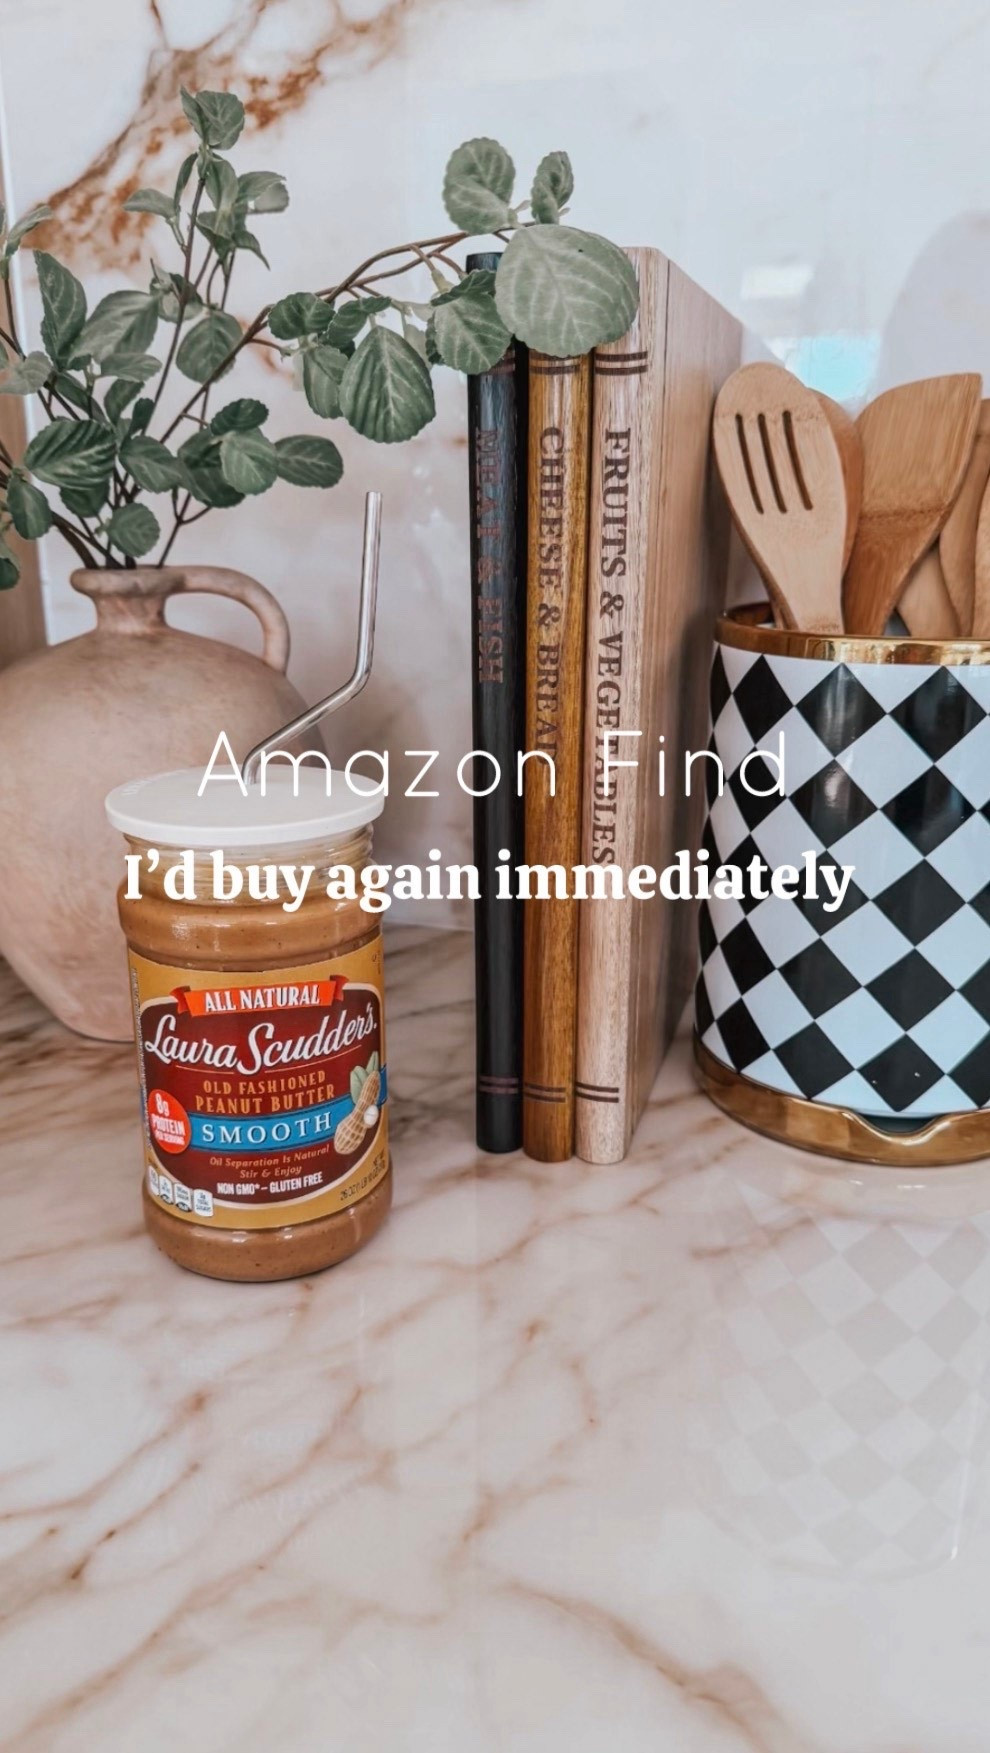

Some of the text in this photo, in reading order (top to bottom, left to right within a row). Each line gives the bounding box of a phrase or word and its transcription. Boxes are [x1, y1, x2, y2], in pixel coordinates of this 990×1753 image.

[475, 427, 501, 539] MEAT
[534, 427, 566, 766] CHEESE & BREAD
[478, 596, 504, 684] FISH
[591, 428, 631, 865] FRUITS & VEGETABLES
[204, 984, 320, 1013] ALL NATURAL
[145, 1002, 375, 1075] Laura Scudder's
[203, 1070, 326, 1095] OLD FASHIONED
[155, 1092, 170, 1117] 8g
[195, 1083, 335, 1115] PEANUT BUTTER
[151, 1113, 186, 1136] PROTEIN
[202, 1112, 332, 1144] SMOOTH
[209, 1144, 330, 1169] Oil Separation Is Natural
[216, 1182, 235, 1195] NON
[269, 1177, 302, 1194] GLUTEN
[303, 1171, 324, 1187] FREE
[240, 1165, 303, 1179] Stir & Enjoy
